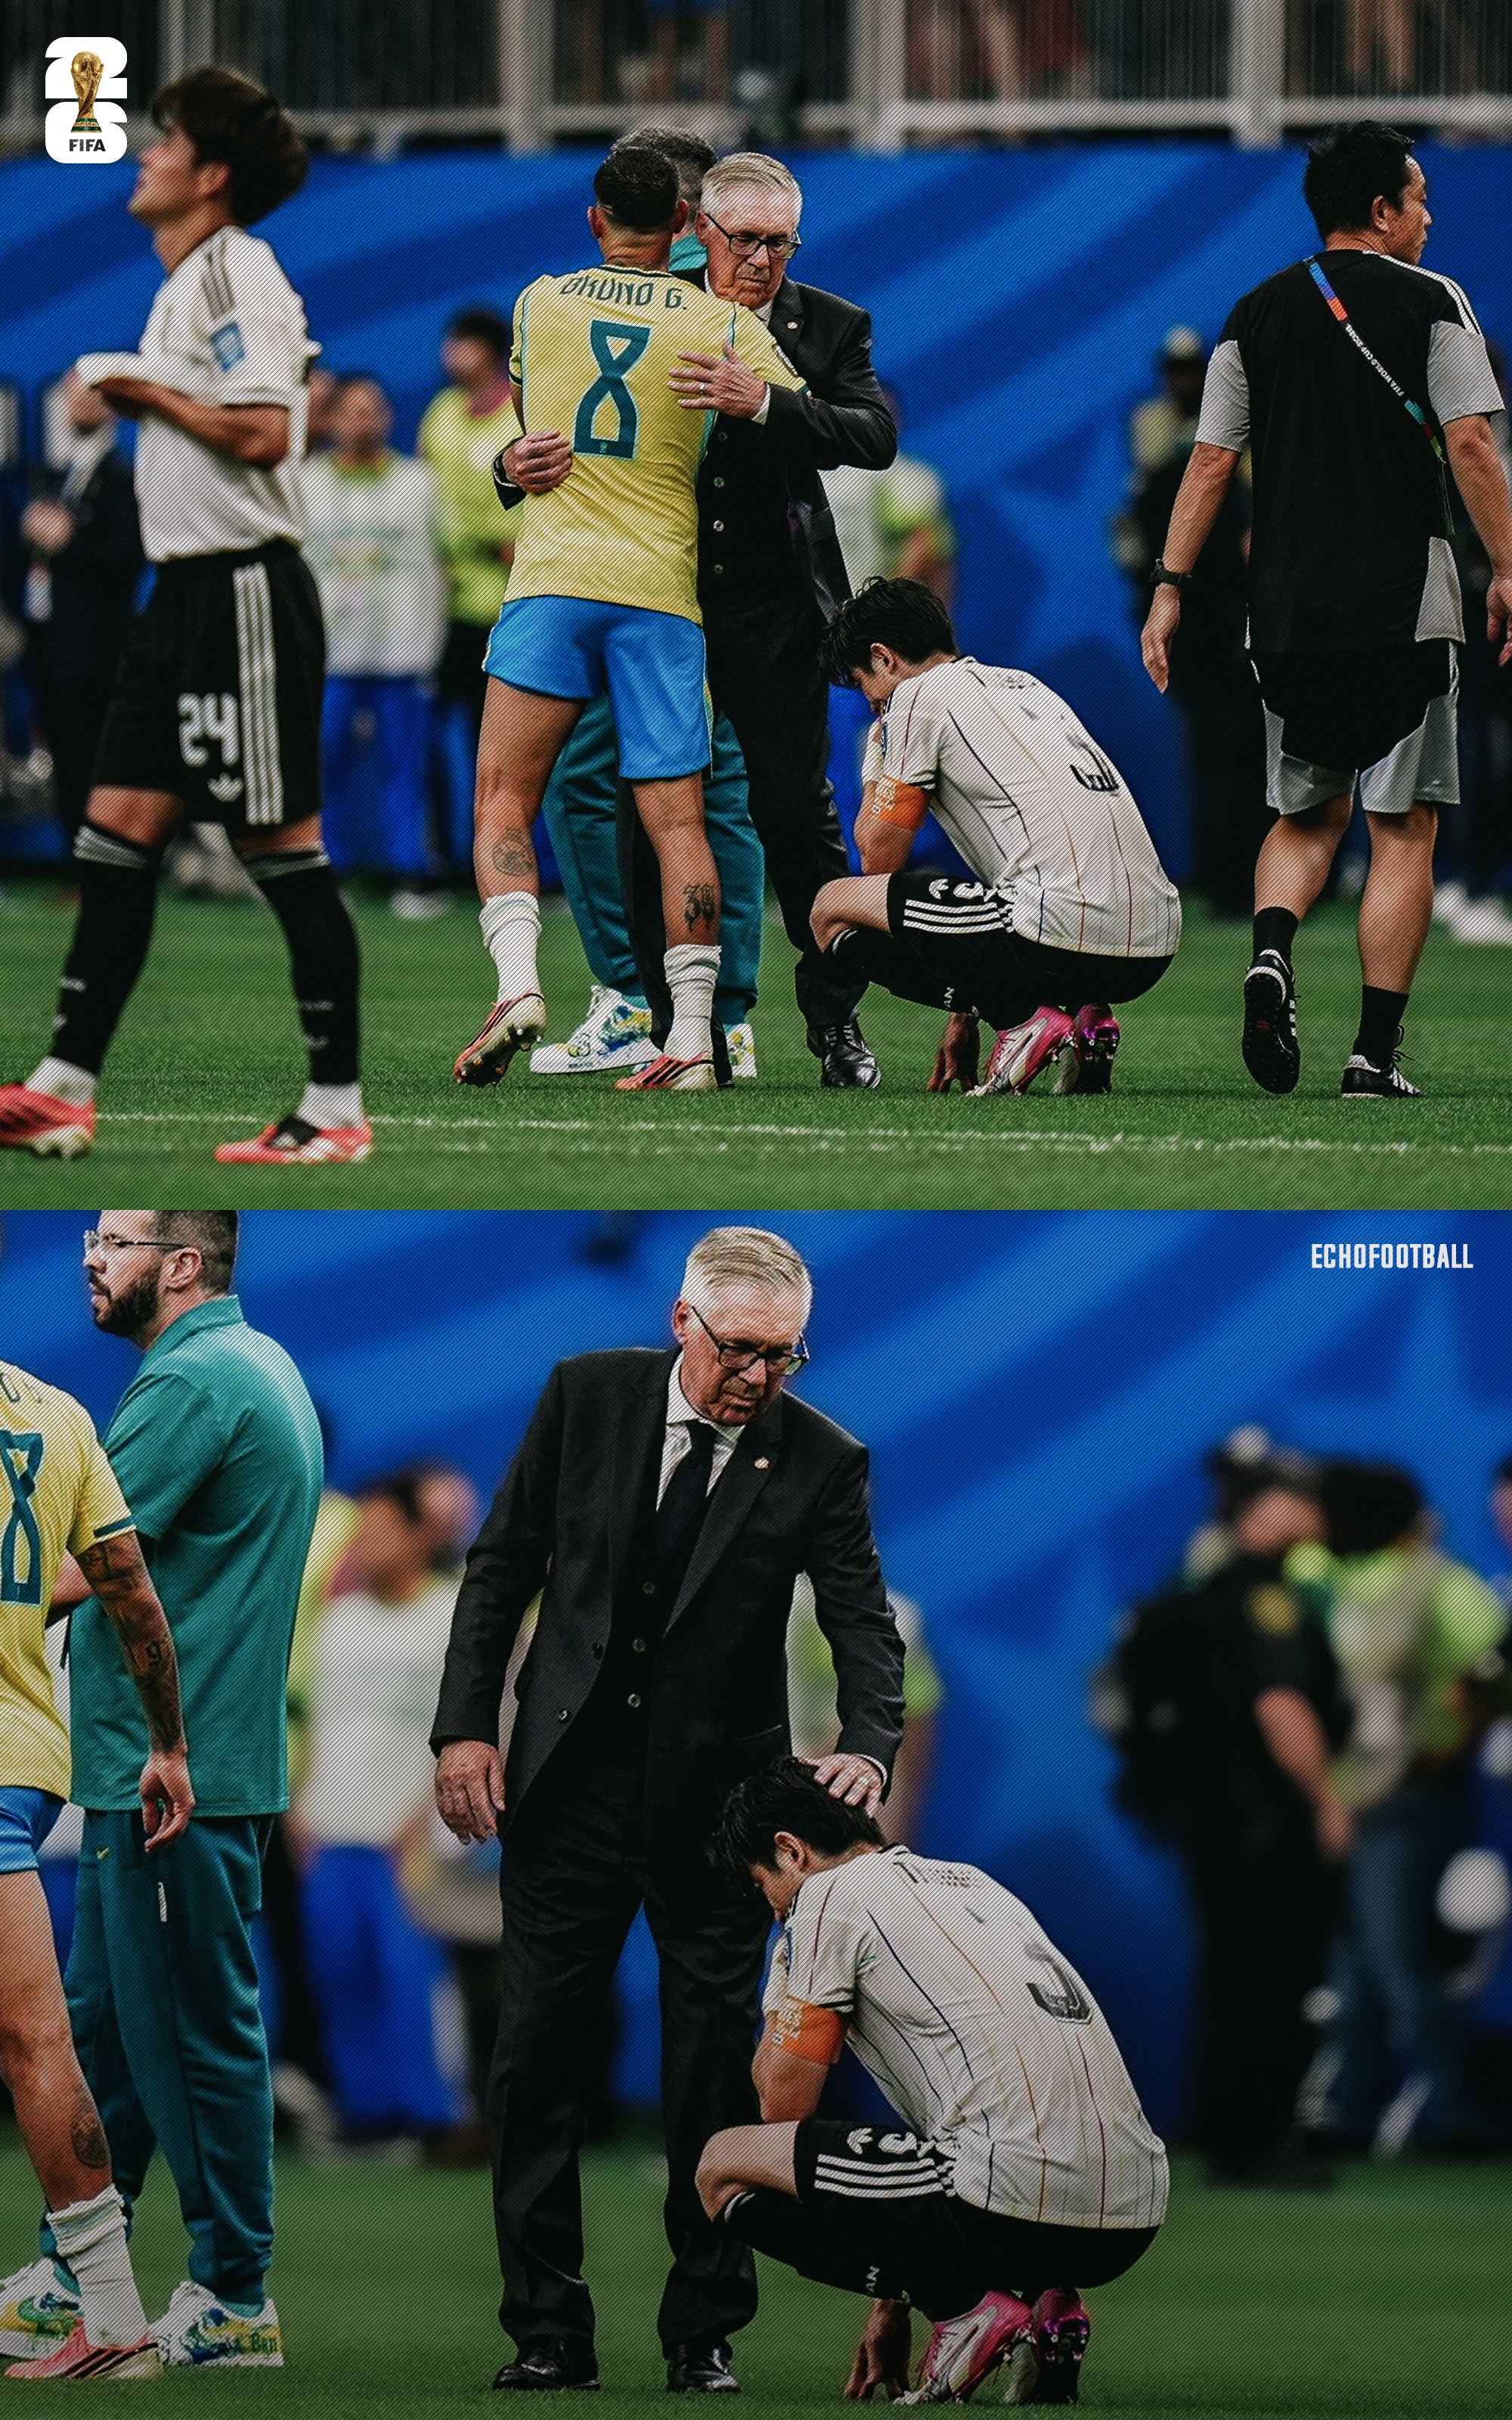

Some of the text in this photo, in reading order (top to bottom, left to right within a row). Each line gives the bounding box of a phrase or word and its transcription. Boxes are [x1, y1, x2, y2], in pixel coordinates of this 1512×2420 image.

[559, 275, 654, 306] BRUNO
[1361, 347, 1373, 360] CUP
[1371, 359, 1392, 383] WORLD
[573, 319, 652, 460] 8
[1390, 380, 1404, 396] FIFA
[176, 692, 240, 768] 24
[0, 1430, 43, 1601] 8
